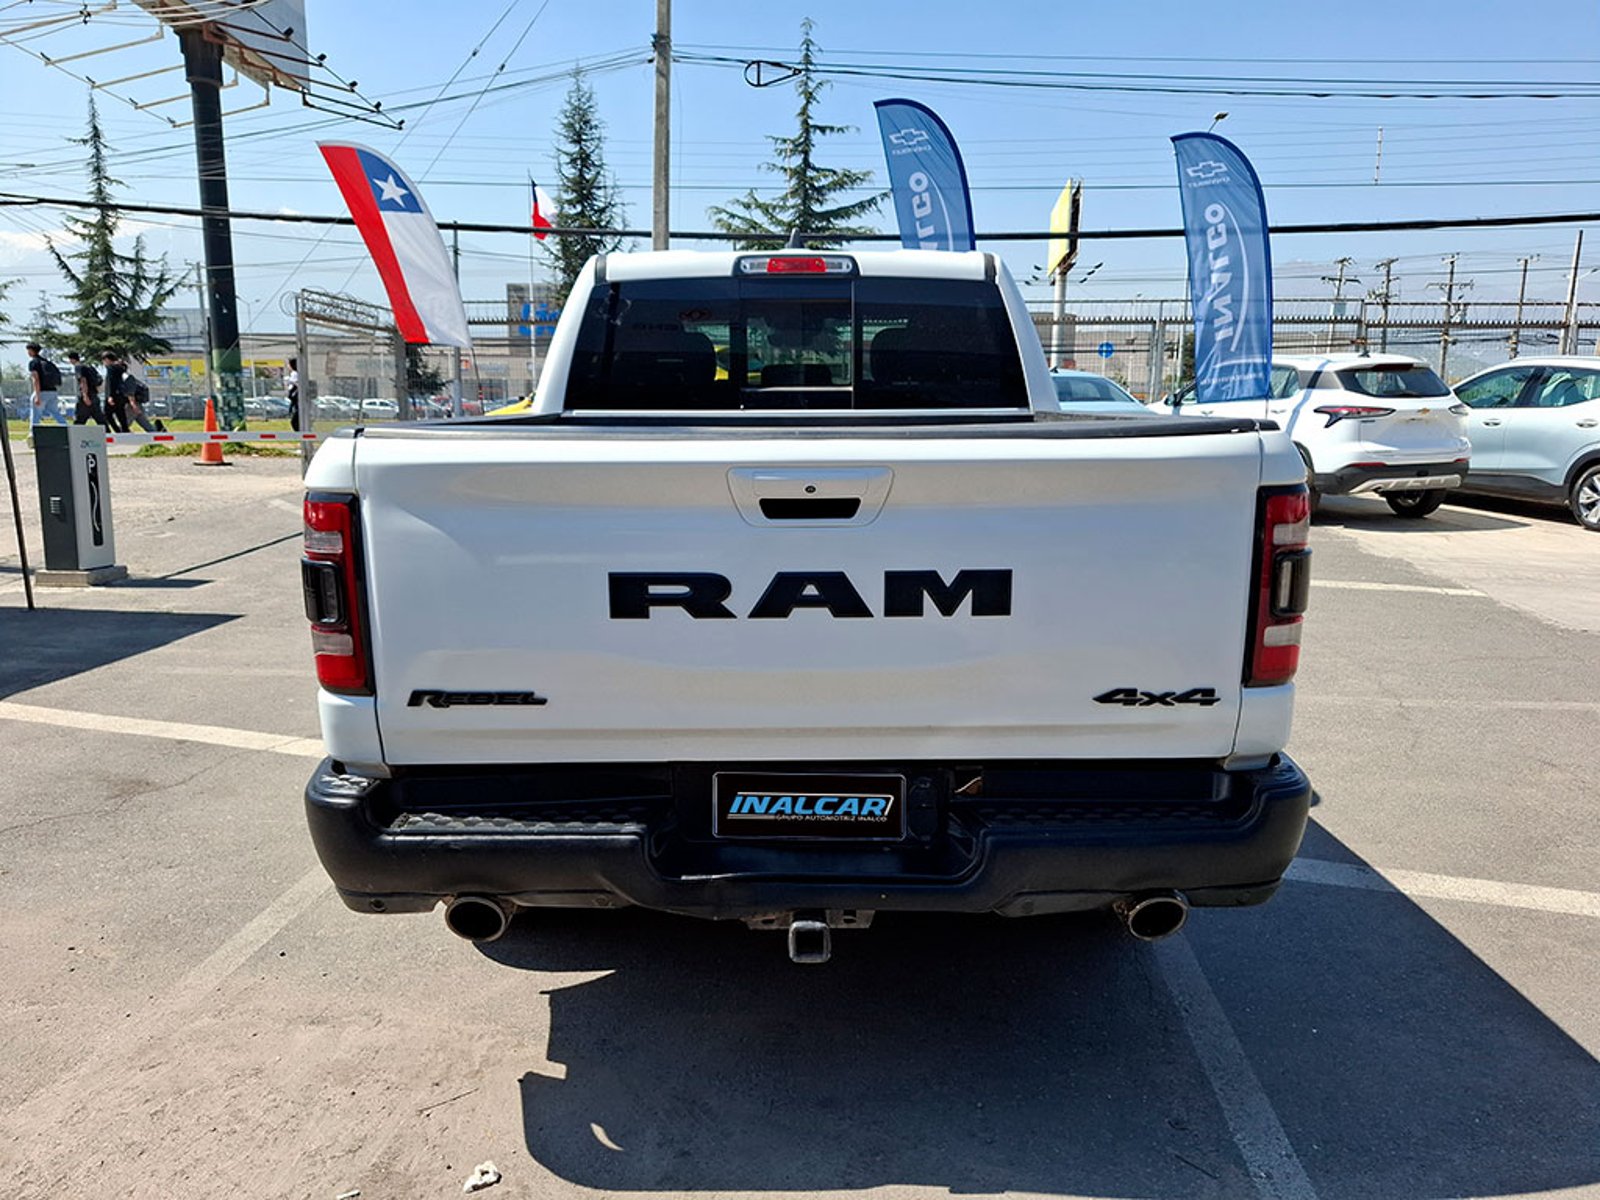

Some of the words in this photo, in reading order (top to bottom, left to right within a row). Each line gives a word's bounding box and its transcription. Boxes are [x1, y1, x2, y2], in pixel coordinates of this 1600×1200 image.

[608, 569, 1013, 619] RAM
[407, 689, 548, 708] REBEL
[1092, 688, 1221, 706] 4x4
[729, 796, 887, 816] INALCAR
[775, 814, 803, 822] GRUPO
